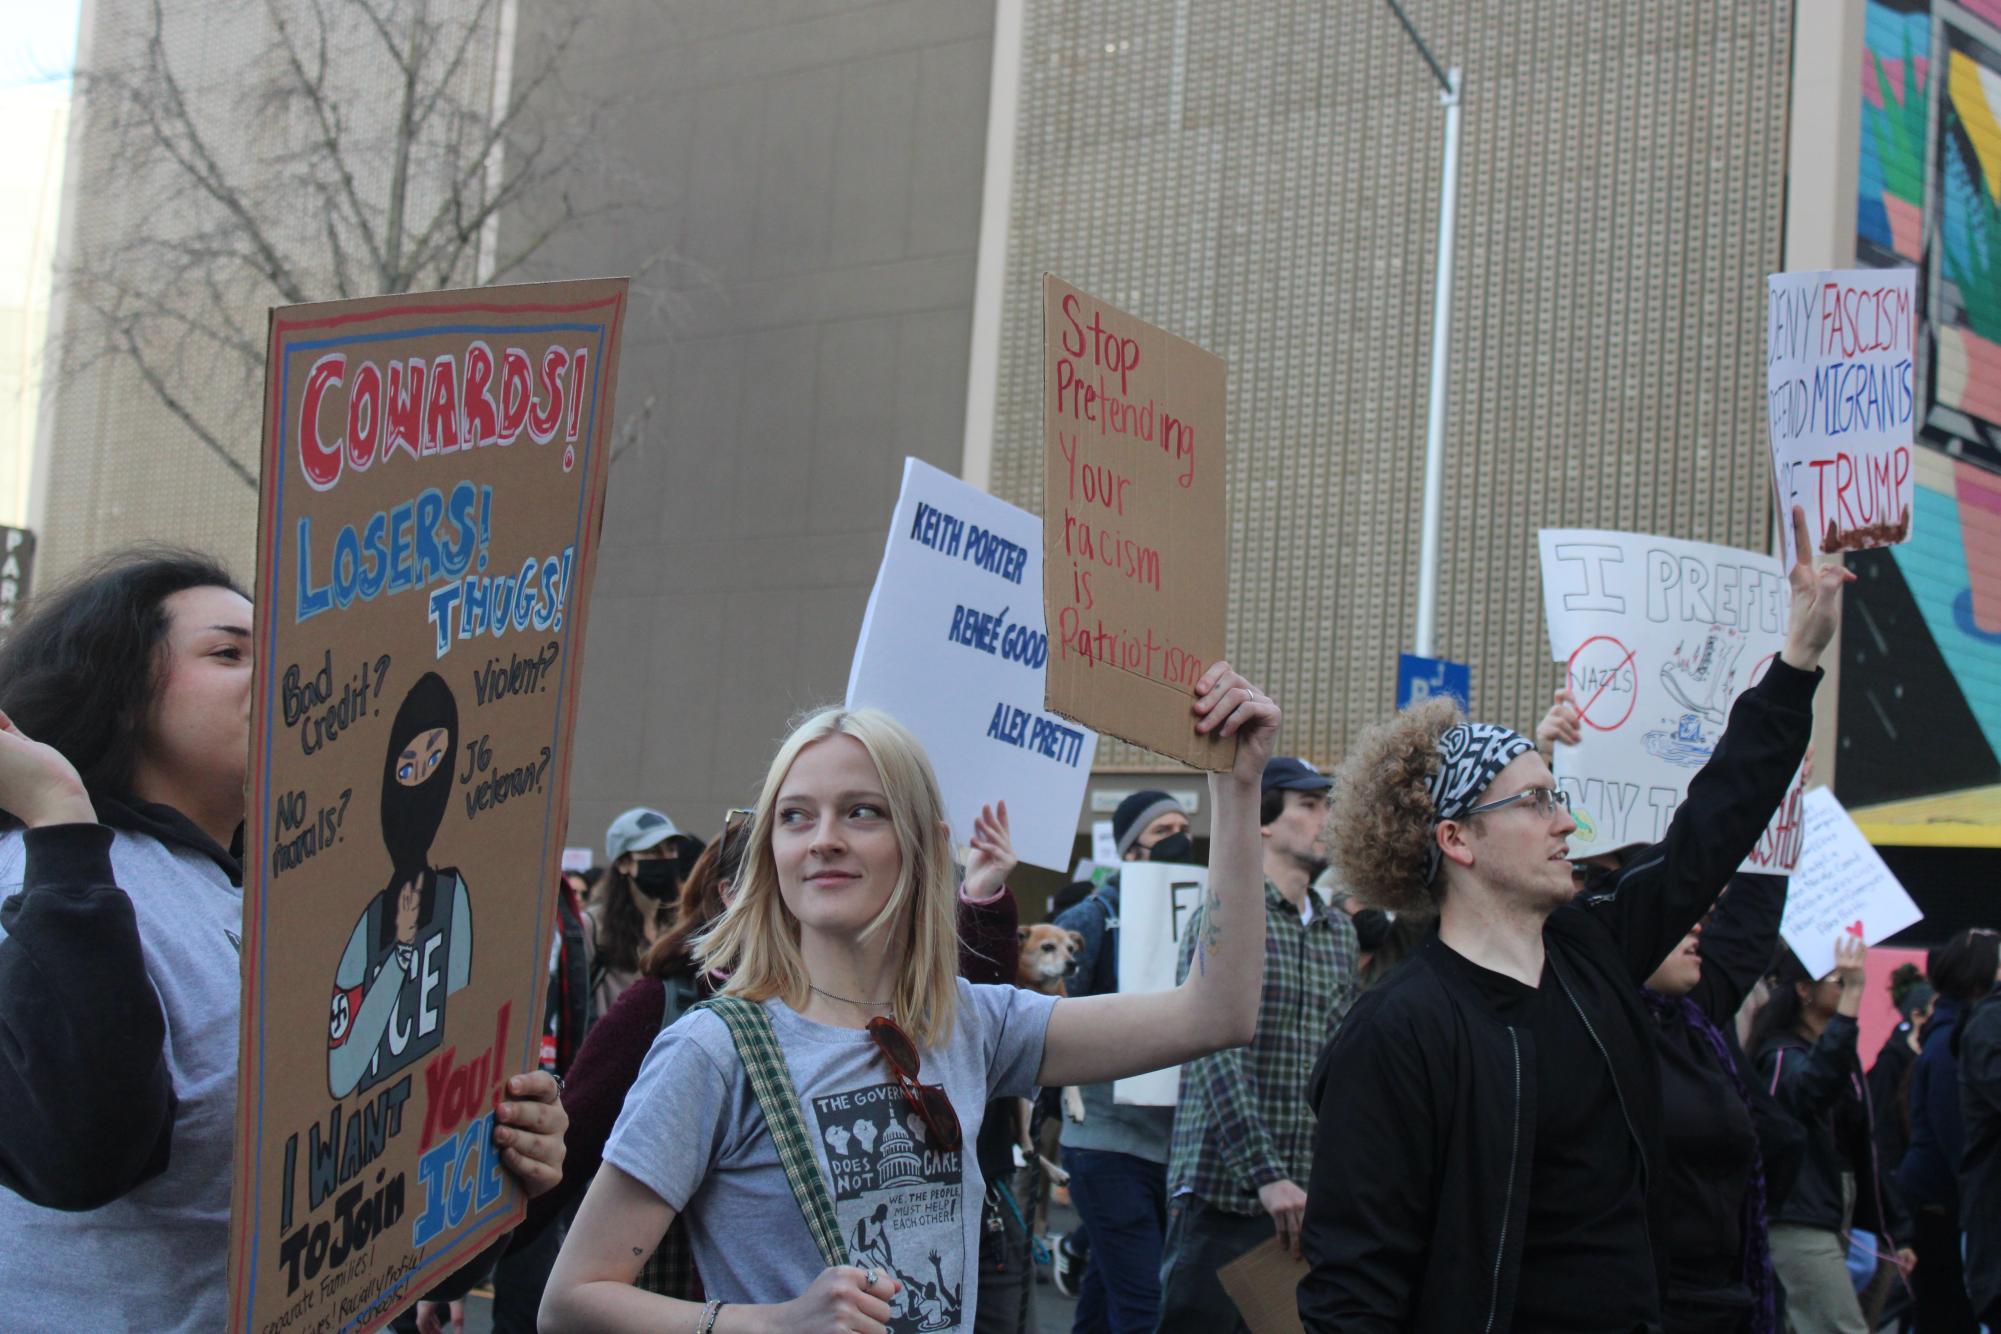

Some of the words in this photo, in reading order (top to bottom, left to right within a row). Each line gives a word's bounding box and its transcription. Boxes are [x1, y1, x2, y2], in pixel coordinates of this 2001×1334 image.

[1062, 294, 1140, 395] Stop
[1820, 283, 1911, 358] FASCISM
[298, 341, 588, 491] COWARDS!
[1056, 358, 1195, 488] Pretending
[1810, 359, 1912, 436] MIGRANTS
[1059, 431, 1131, 516] Your
[1809, 446, 1910, 537] TRUMP
[296, 480, 492, 623] LOSERS!
[910, 502, 962, 560] KEITH
[963, 521, 1028, 585] PORTER
[1064, 508, 1161, 592] racism
[1556, 544, 1626, 614] I
[429, 545, 573, 659] THUGS!
[1073, 561, 1094, 611] is
[474, 641, 559, 705] Violent?
[1001, 620, 1049, 669] GOOD
[1059, 607, 1202, 687] Patriotism
[1569, 665, 1632, 693] NAZIS
[283, 650, 333, 727] Bad
[302, 654, 391, 755] Credit?
[460, 735, 492, 783] J6
[987, 702, 1030, 750] ALEX
[1031, 715, 1085, 768] PRETTI
[817, 1094, 851, 1114] THE
[281, 1133, 297, 1235] I
[309, 1078, 411, 1211] WANT
[413, 1112, 502, 1247] ICE
[832, 1157, 871, 1174] DOES
[837, 1173, 875, 1193] NOT
[894, 1218, 917, 1230] EACH
[895, 1204, 921, 1216] MUST
[925, 1201, 949, 1213] HELP
[909, 1191, 928, 1201] THE
